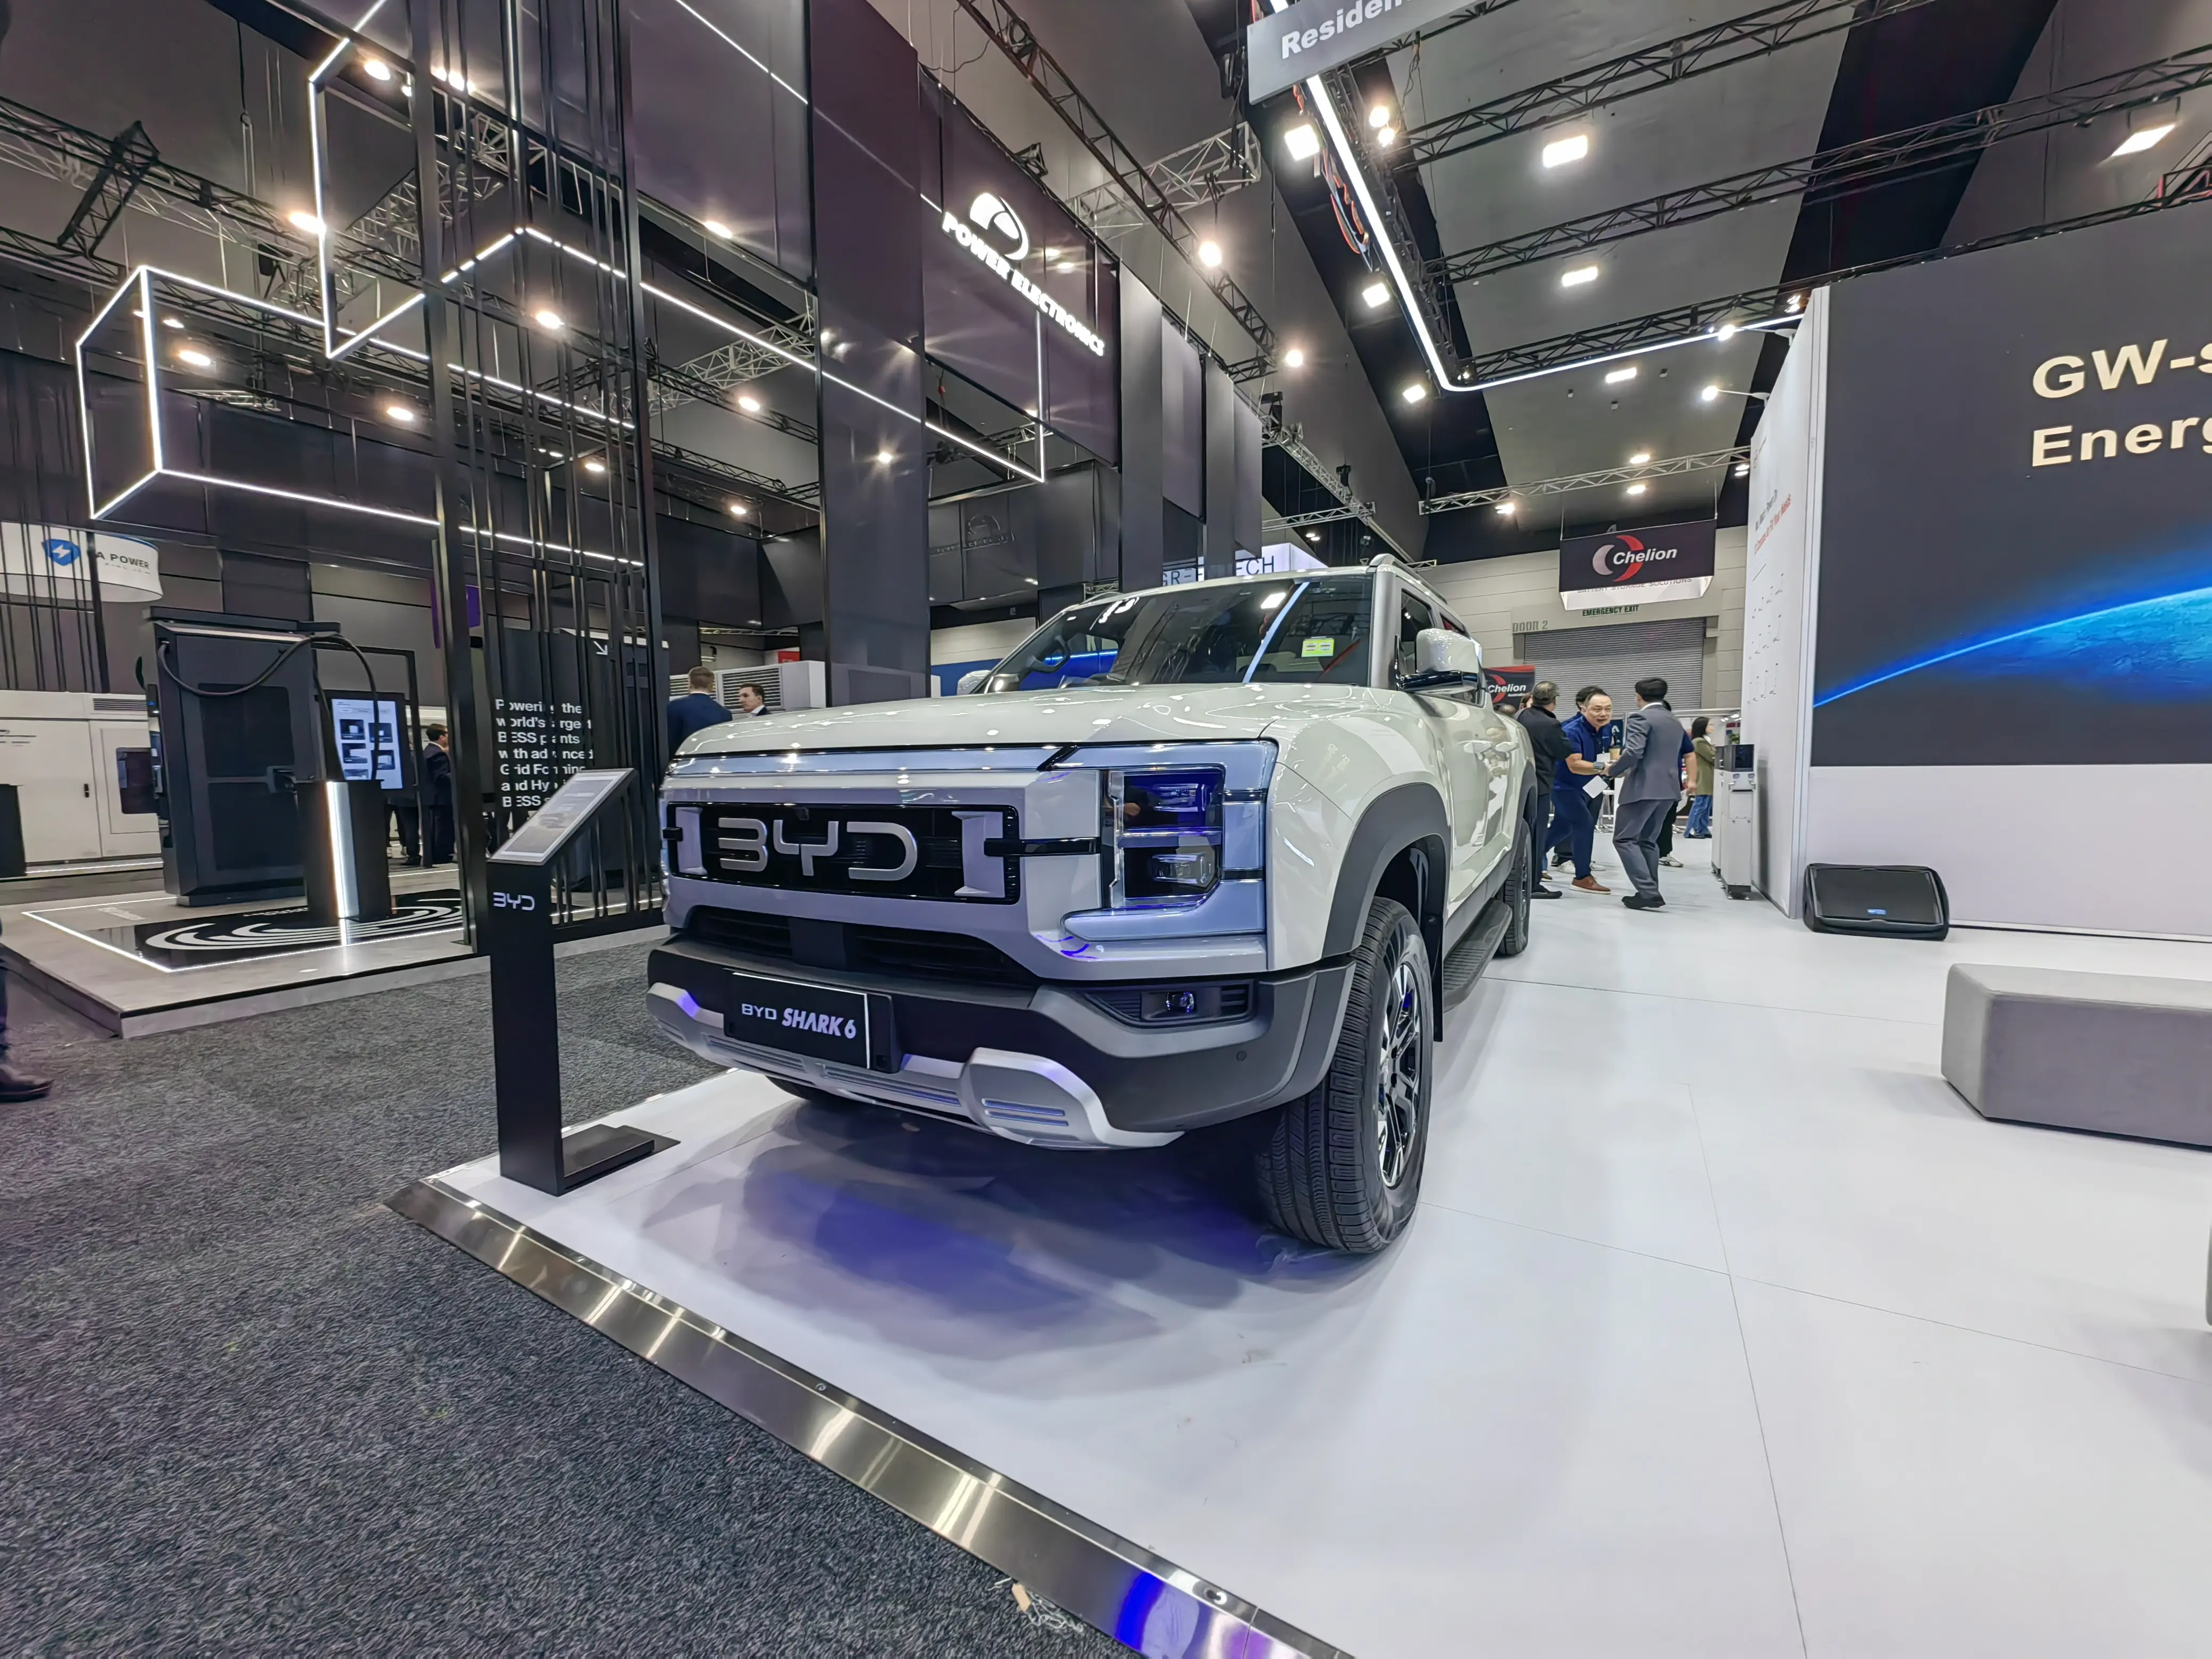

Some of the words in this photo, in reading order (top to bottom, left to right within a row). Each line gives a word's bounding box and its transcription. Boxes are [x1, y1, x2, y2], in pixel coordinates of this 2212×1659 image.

[942, 212, 1010, 280] POWER
[1011, 269, 1104, 356] ELECTRONICS
[2032, 417, 2212, 466] Ener
[110, 554, 149, 569] POWER
[1613, 548, 1678, 565] Chelion
[1582, 606, 1622, 616] EMERGENCY
[1542, 620, 1548, 630] 2
[1488, 684, 1526, 693] Chelion
[562, 703, 582, 714] the
[717, 817, 918, 881] BYD
[493, 892, 535, 911] BYD
[741, 1003, 777, 1020] BYD
[782, 1008, 844, 1036] SHARK
[844, 1019, 857, 1038] 6
